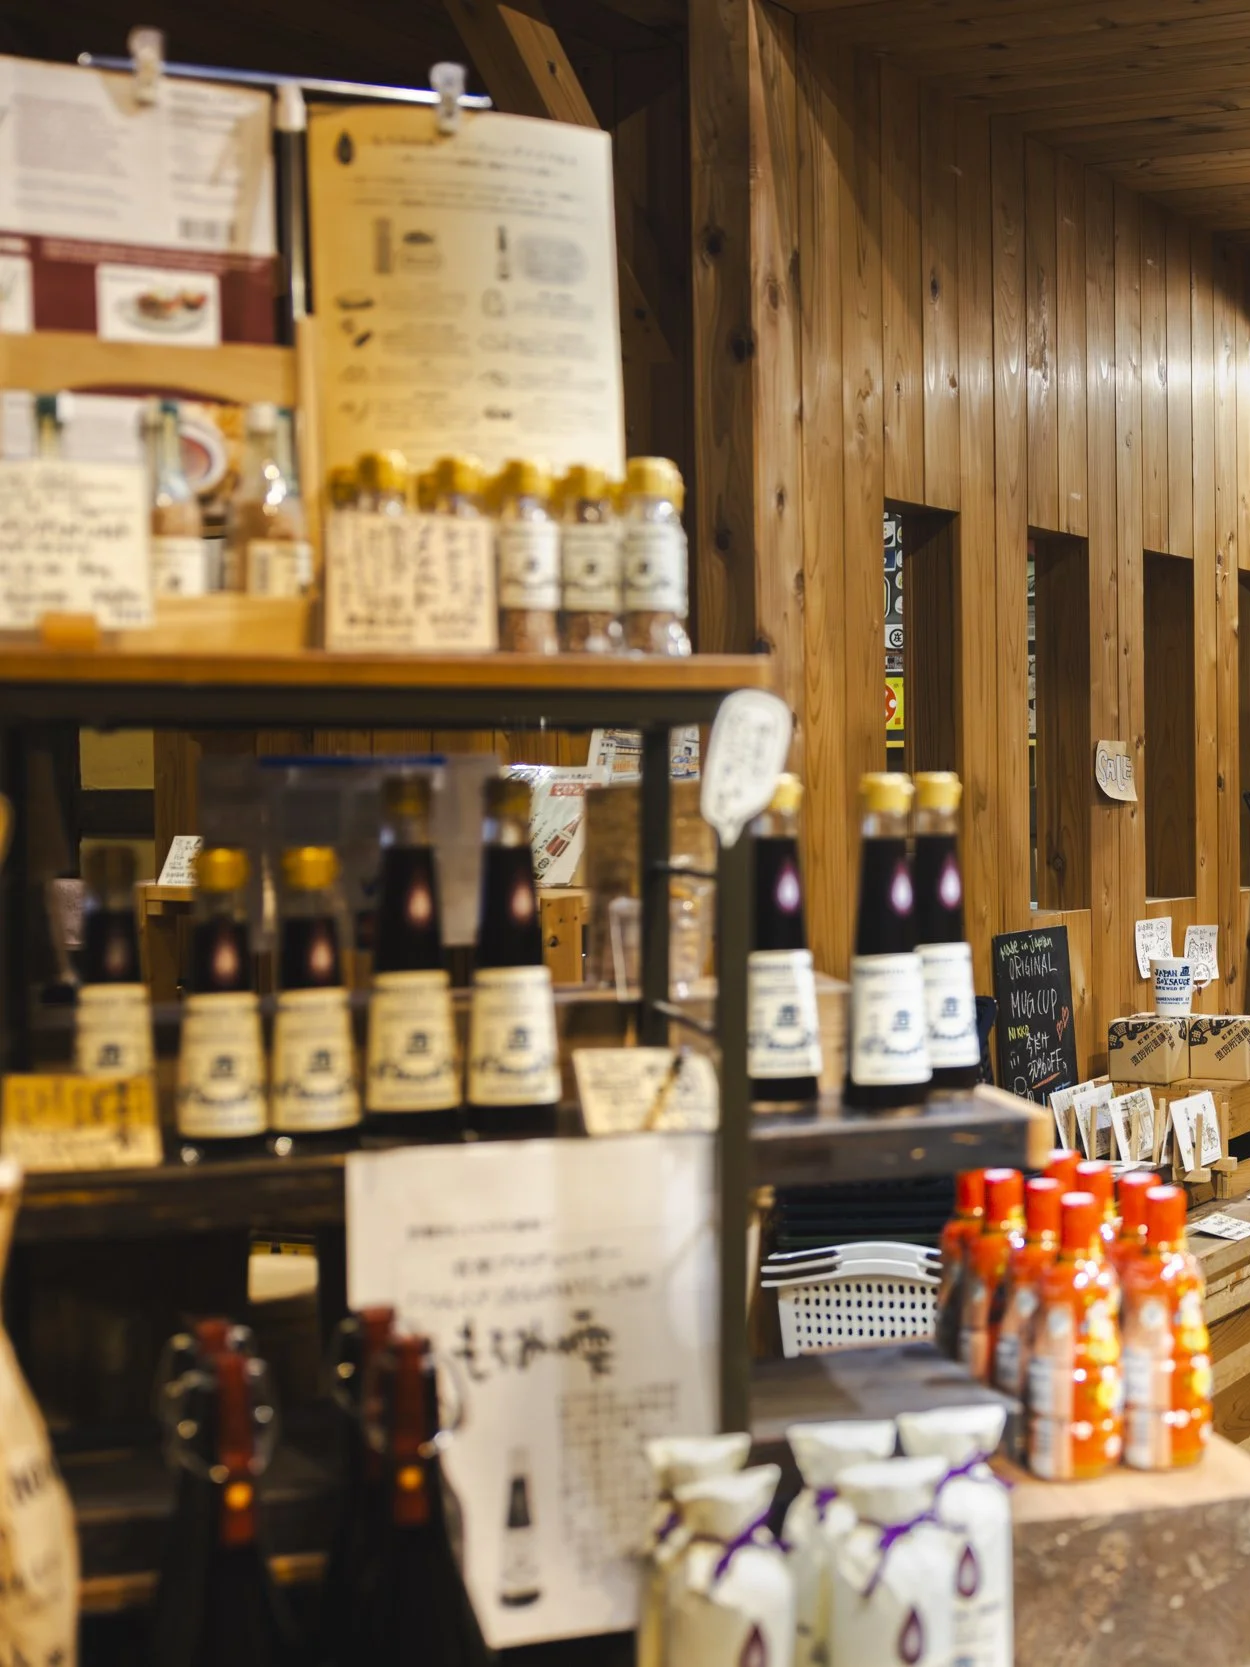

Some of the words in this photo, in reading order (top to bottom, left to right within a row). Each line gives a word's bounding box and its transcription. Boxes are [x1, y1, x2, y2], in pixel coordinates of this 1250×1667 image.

[1098, 749, 1132, 791] SALE
[1008, 951, 1058, 980] ORIGINAL
[1154, 968, 1178, 978] JAPAN
[1010, 989, 1035, 1018] MUG
[1037, 988, 1058, 1020] CUP
[1007, 1024, 1030, 1041] NIKKO
